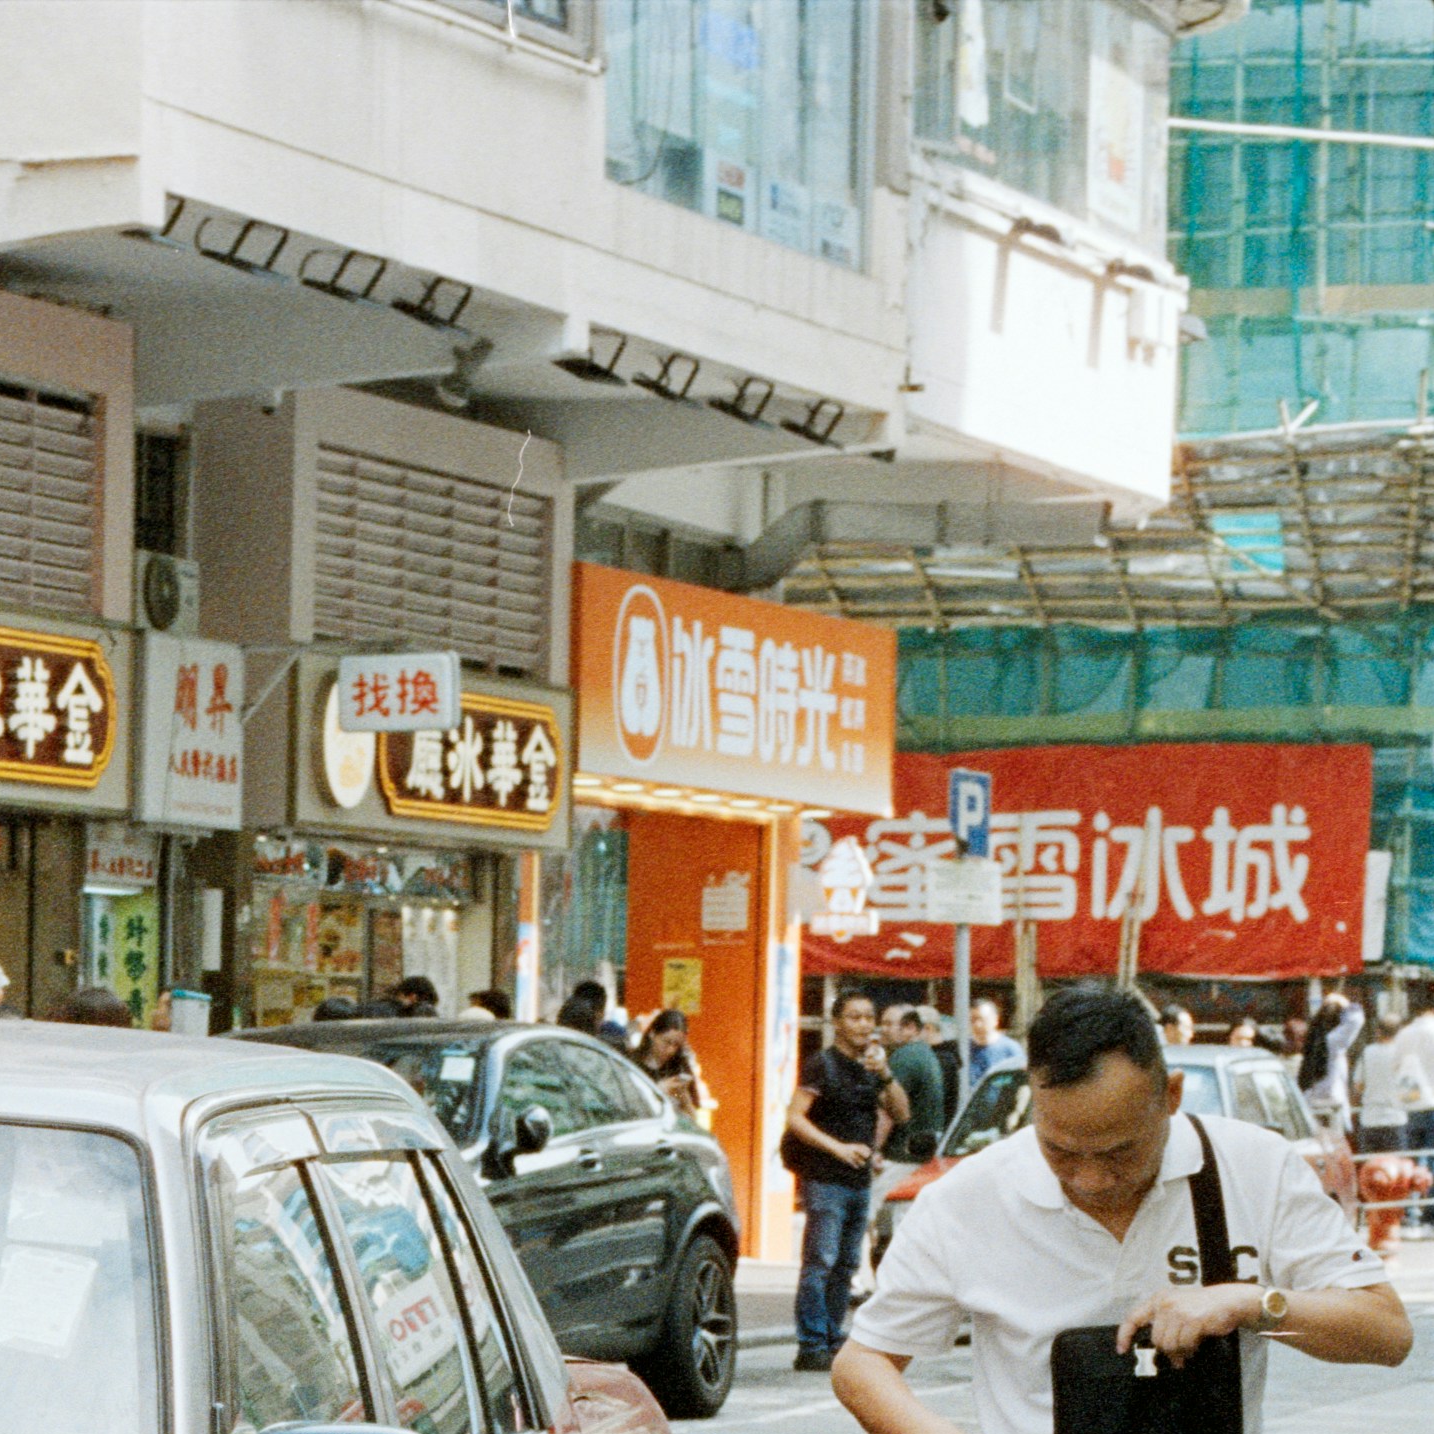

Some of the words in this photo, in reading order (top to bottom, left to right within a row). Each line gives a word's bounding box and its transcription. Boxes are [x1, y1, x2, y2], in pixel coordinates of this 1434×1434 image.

[351, 669, 440, 717] 找換
[671, 615, 838, 773] 冰雪時光
[958, 781, 985, 841] P
[864, 803, 1312, 924] 蜜雪冰城
